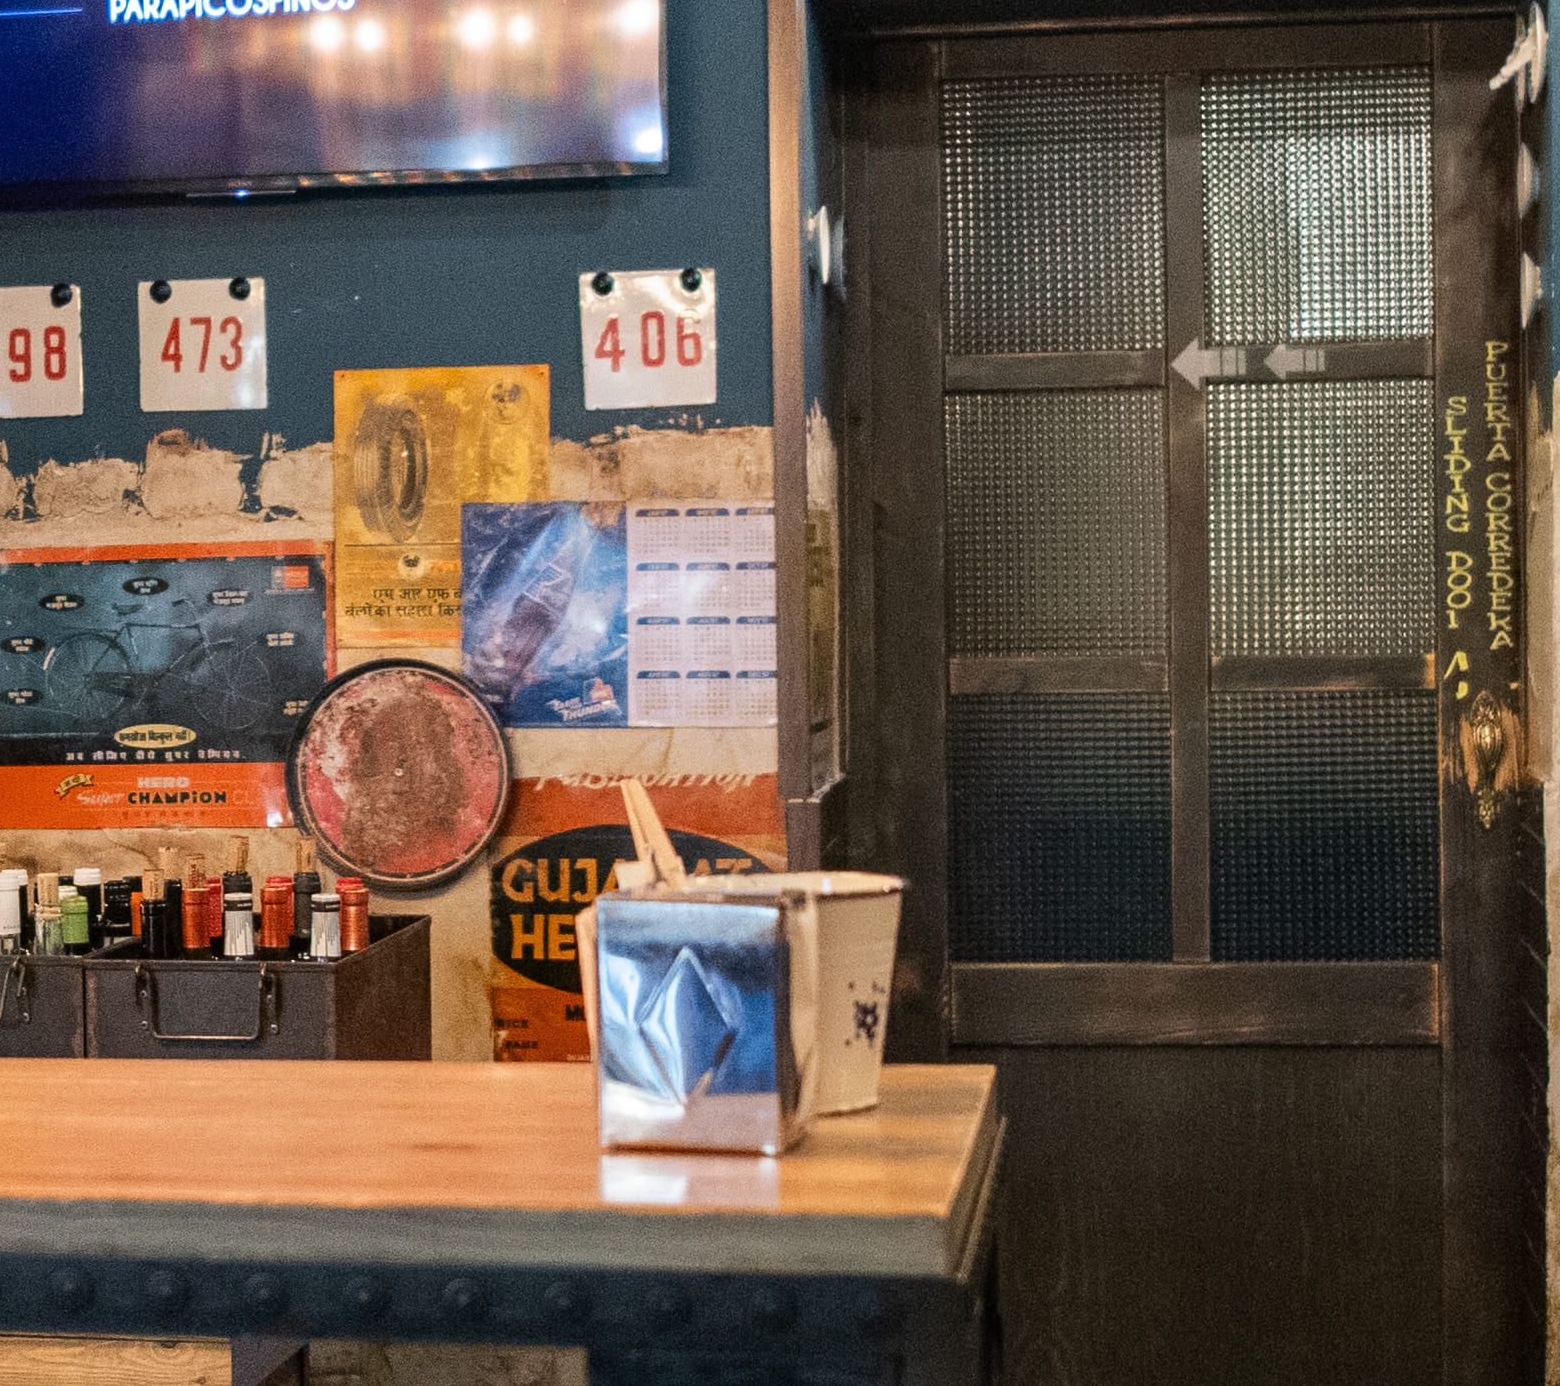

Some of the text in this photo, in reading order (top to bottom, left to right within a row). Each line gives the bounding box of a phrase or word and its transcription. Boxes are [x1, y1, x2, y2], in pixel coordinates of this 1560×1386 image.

[161, 316, 243, 374] 473
[594, 310, 703, 373] 406
[1484, 341, 1512, 461] PUERTA
[1443, 396, 1472, 533] SLIDING
